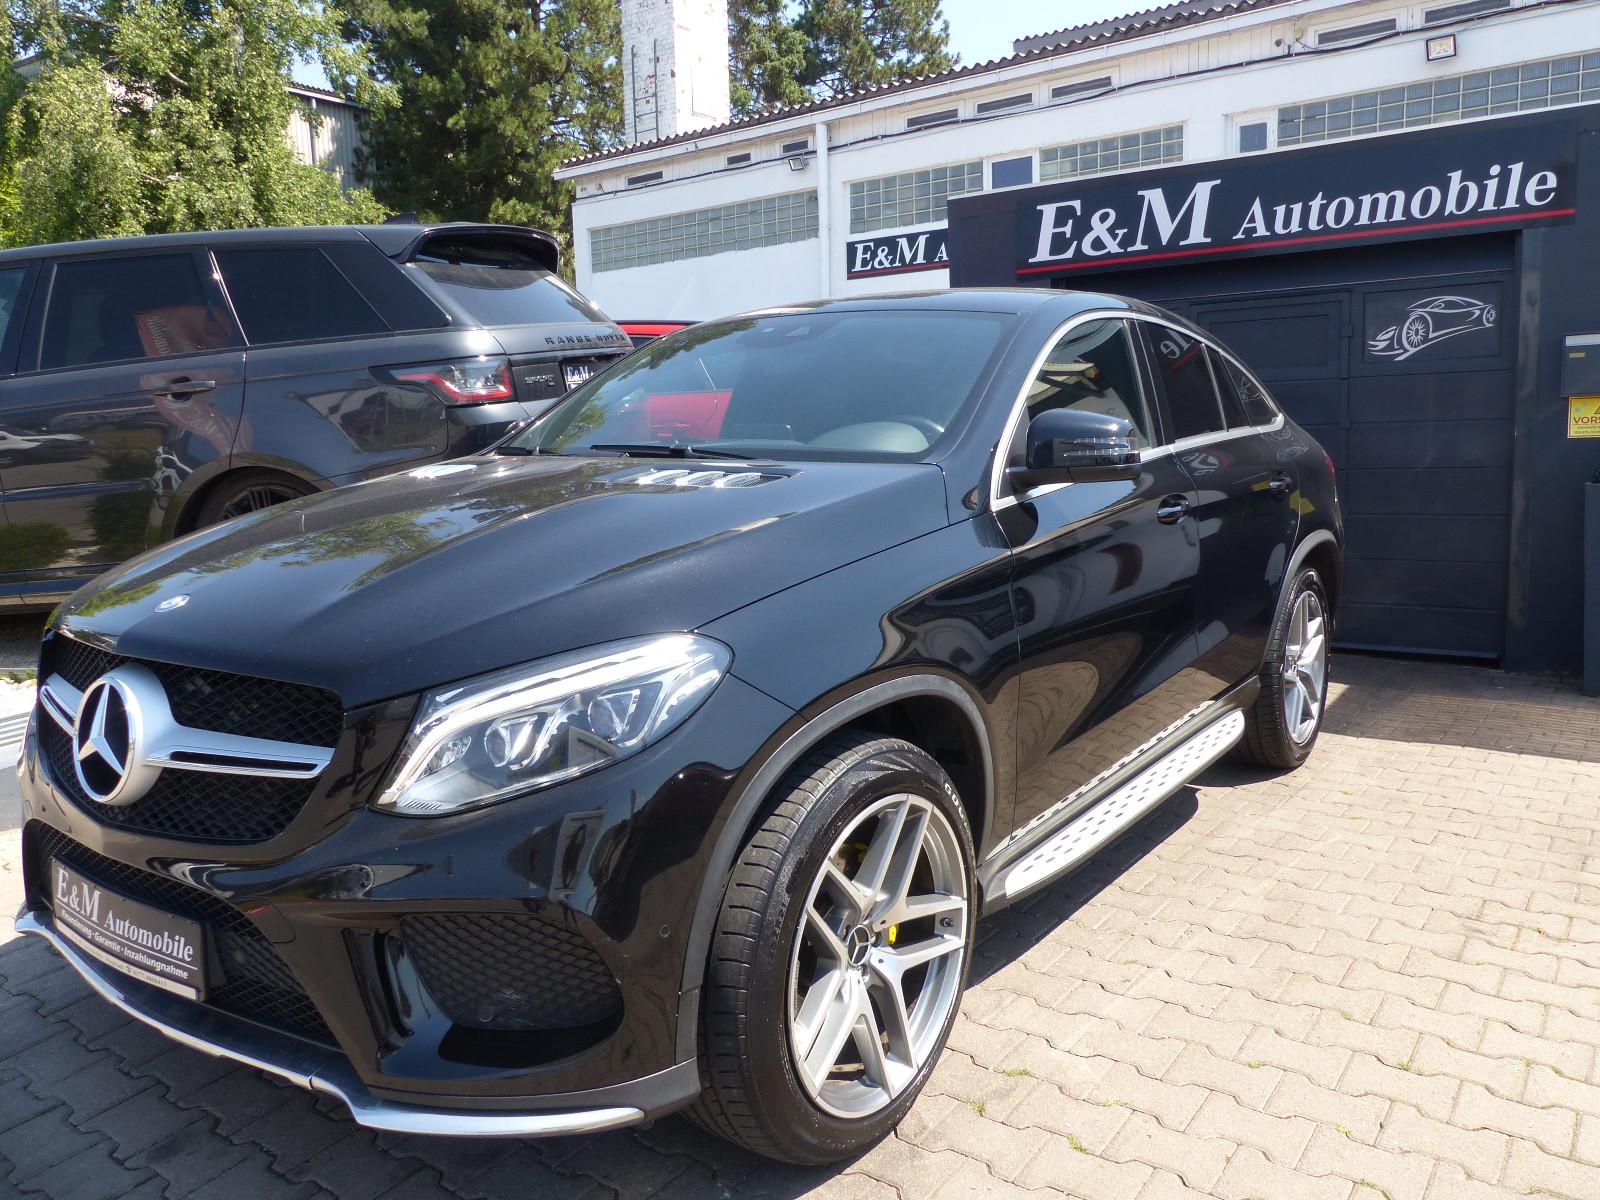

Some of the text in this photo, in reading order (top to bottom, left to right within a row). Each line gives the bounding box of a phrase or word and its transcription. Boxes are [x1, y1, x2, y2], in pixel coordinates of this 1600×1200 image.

[1028, 161, 1558, 264] E&M Automobile
[851, 234, 930, 272] E&M
[544, 335, 592, 345] RANGE
[566, 366, 590, 382] E&M
[56, 867, 102, 924] E&M
[104, 910, 194, 962] Automobile
[61, 909, 92, 940] Finanzierung
[94, 932, 121, 953] Garantie
[124, 946, 189, 979] Inzahlungnahme
